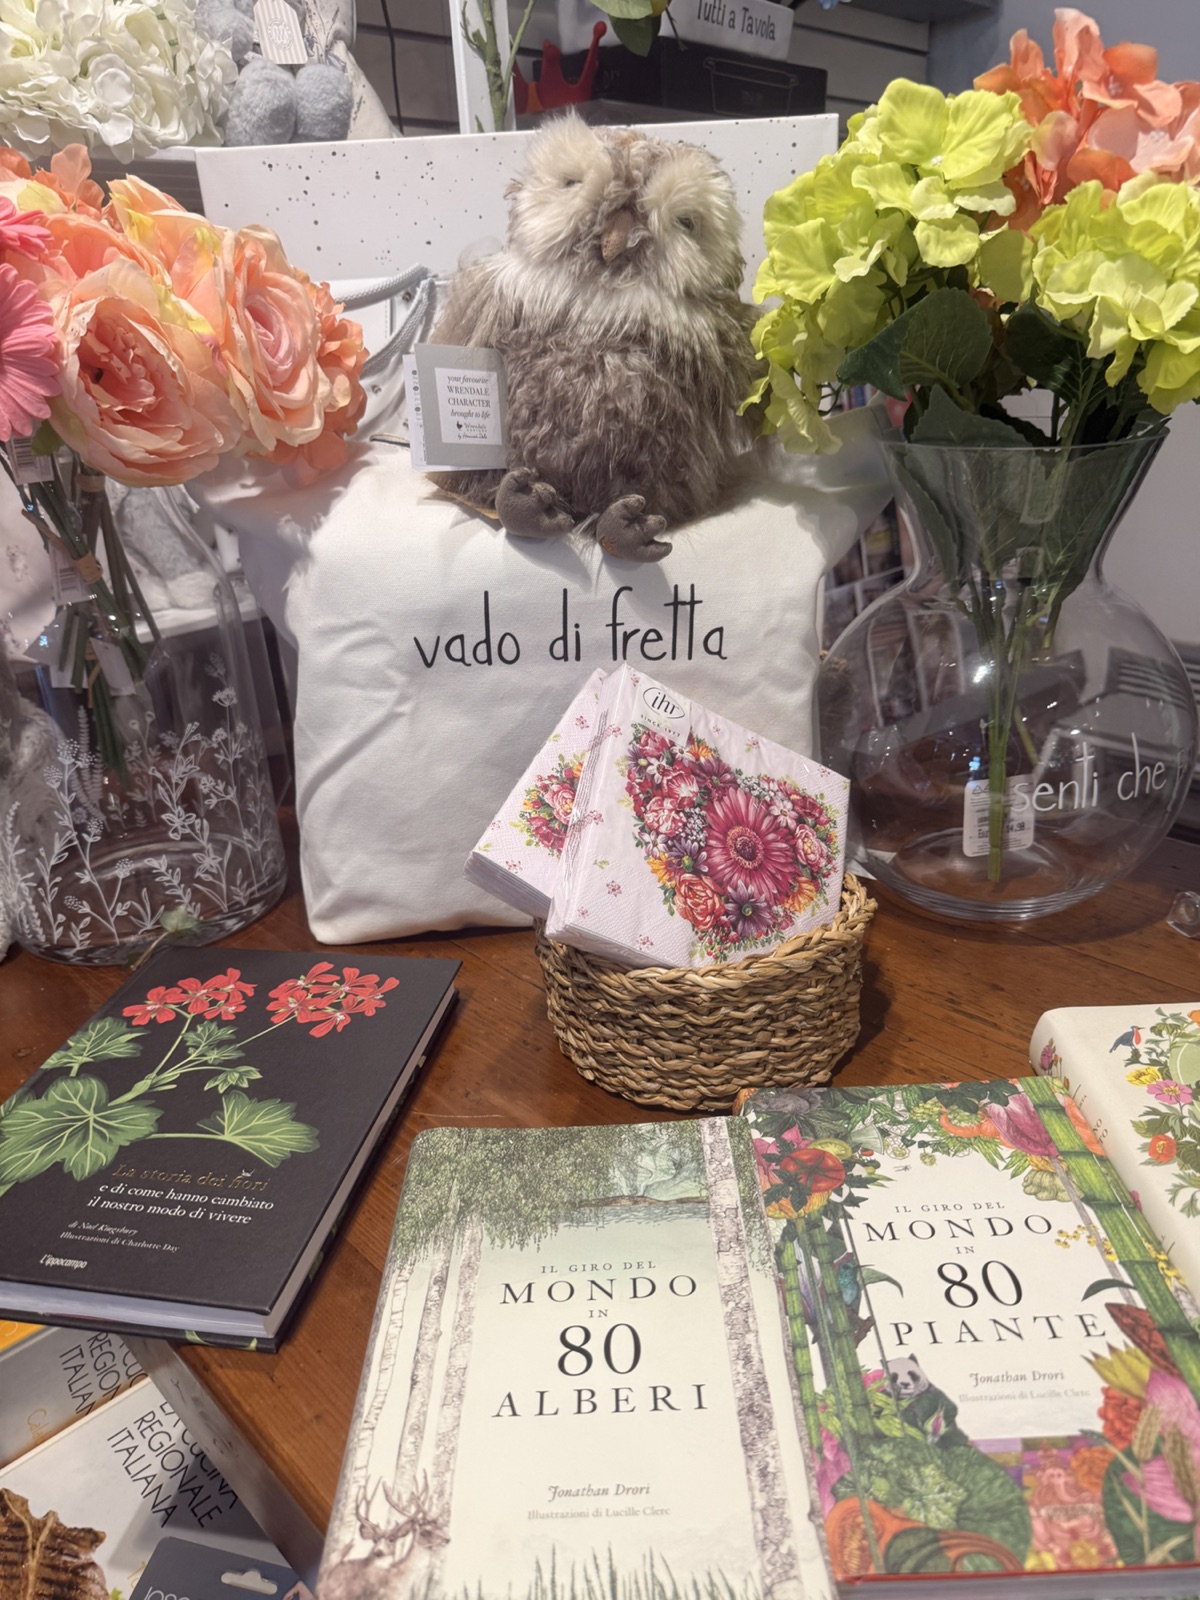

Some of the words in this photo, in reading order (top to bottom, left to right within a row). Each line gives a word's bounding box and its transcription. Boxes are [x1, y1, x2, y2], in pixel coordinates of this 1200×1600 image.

[728, 10, 736, 29] a
[741, 6, 776, 41] Tavola
[447, 375, 461, 384] your
[461, 375, 489, 384] favourite
[447, 386, 490, 396] WRENDALE
[448, 398, 491, 408] CHARACTER
[451, 409, 474, 419] brought
[481, 410, 491, 419] life
[413, 590, 521, 668] vado
[549, 588, 581, 662] di
[605, 583, 728, 662] fretta
[651, 691, 680, 715] ihr
[641, 713, 661, 728] SINCE
[1011, 741, 1099, 812] senti
[1117, 731, 1167, 800] che
[112, 1164, 136, 1178] La
[140, 1169, 193, 1184] storia
[197, 1172, 228, 1188] dei
[228, 1173, 271, 1192] fiori
[99, 1184, 109, 1193] e
[110, 1182, 129, 1195] di
[127, 1188, 164, 1199] come
[165, 1188, 209, 1203] hanno
[211, 1196, 275, 1210] cambiato
[895, 1205, 911, 1213] IL
[921, 1203, 963, 1212] GIRO
[973, 1201, 1006, 1210] DEL
[86, 1196, 101, 1207] il
[100, 1200, 145, 1213] nostro
[146, 1205, 187, 1217] modo
[188, 1207, 207, 1220] di
[208, 1210, 252, 1225] vivere
[98, 1224, 139, 1237] Kingsbury
[862, 1214, 1052, 1242] MONDO
[60, 1231, 111, 1244] Illustrazioni
[121, 1239, 162, 1250] Charlotte
[162, 1243, 181, 1253] Day
[955, 1246, 975, 1254] IN
[541, 1265, 558, 1274] IL
[569, 1262, 613, 1273] GIRO
[623, 1261, 656, 1270] DEL
[499, 1274, 697, 1305] MONDO
[937, 1260, 1023, 1308] 80
[589, 1309, 609, 1318] IN
[890, 1313, 1107, 1347] PIANTE
[557, 1322, 641, 1377] 80
[969, 1370, 1027, 1388] Jonathan
[1031, 1369, 1064, 1381] Drori
[490, 1383, 709, 1419] ALBERI
[958, 1392, 1016, 1403] Illustrazioni
[1018, 1390, 1028, 1400] di
[1030, 1389, 1061, 1399] Lucille
[107, 1427, 178, 1528] ITALIANA
[133, 1410, 223, 1528] REGIONALE
[547, 1483, 609, 1503] Jonathan
[614, 1482, 650, 1496] Drori
[528, 1507, 590, 1520] Illustrazioni
[592, 1507, 602, 1518] di
[605, 1505, 641, 1517] Lucille
[642, 1505, 671, 1516] Clerc
